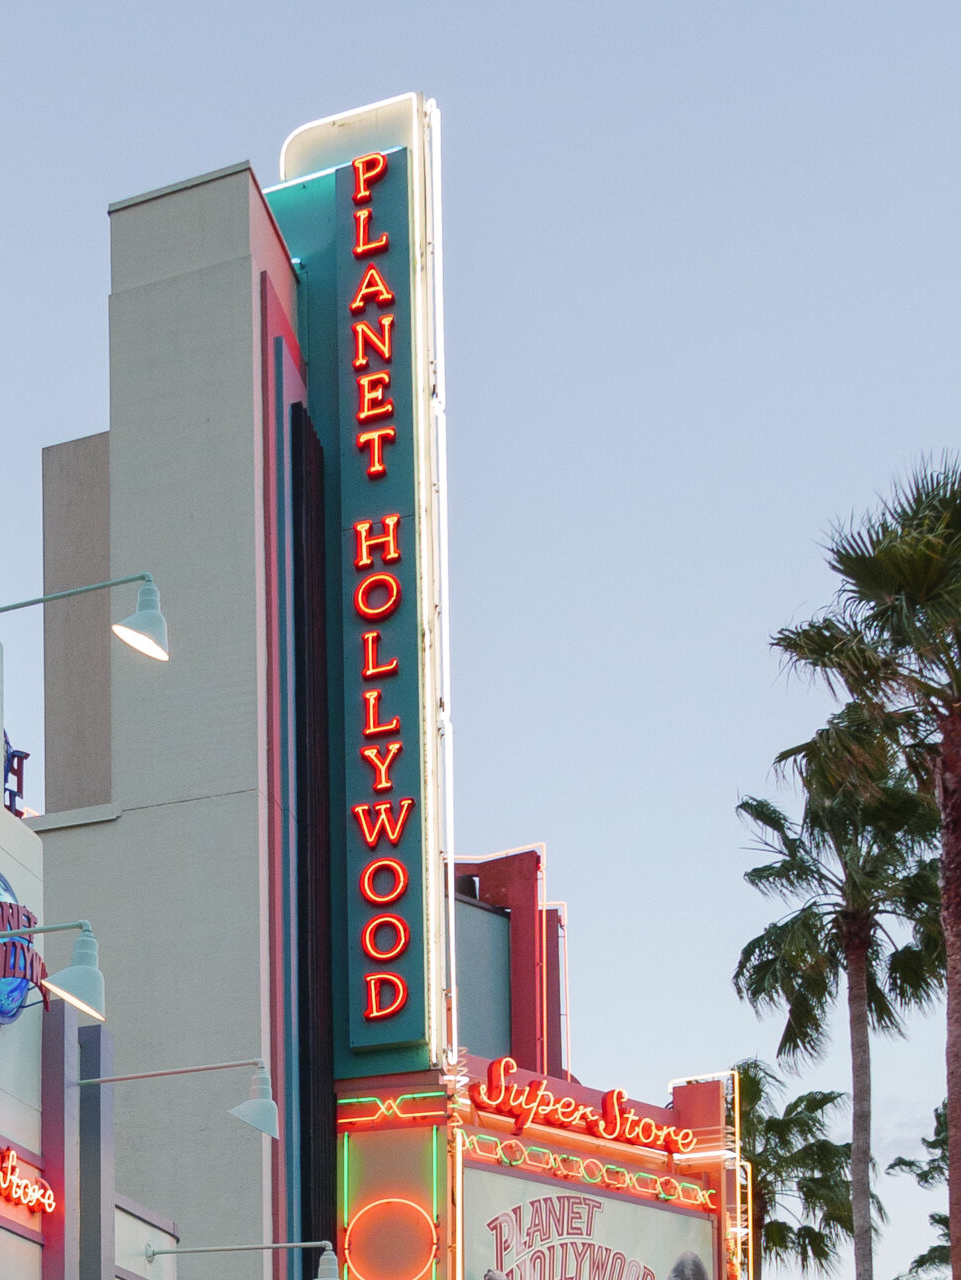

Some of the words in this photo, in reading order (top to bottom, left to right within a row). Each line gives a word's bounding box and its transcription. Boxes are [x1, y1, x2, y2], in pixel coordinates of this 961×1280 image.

[348, 151, 398, 481] PLANET
[350, 513, 415, 1022] HOLLYWOOD
[471, 1056, 598, 1132] Super
[598, 1087, 697, 1154] Store
[486, 1193, 604, 1271] PLANET
